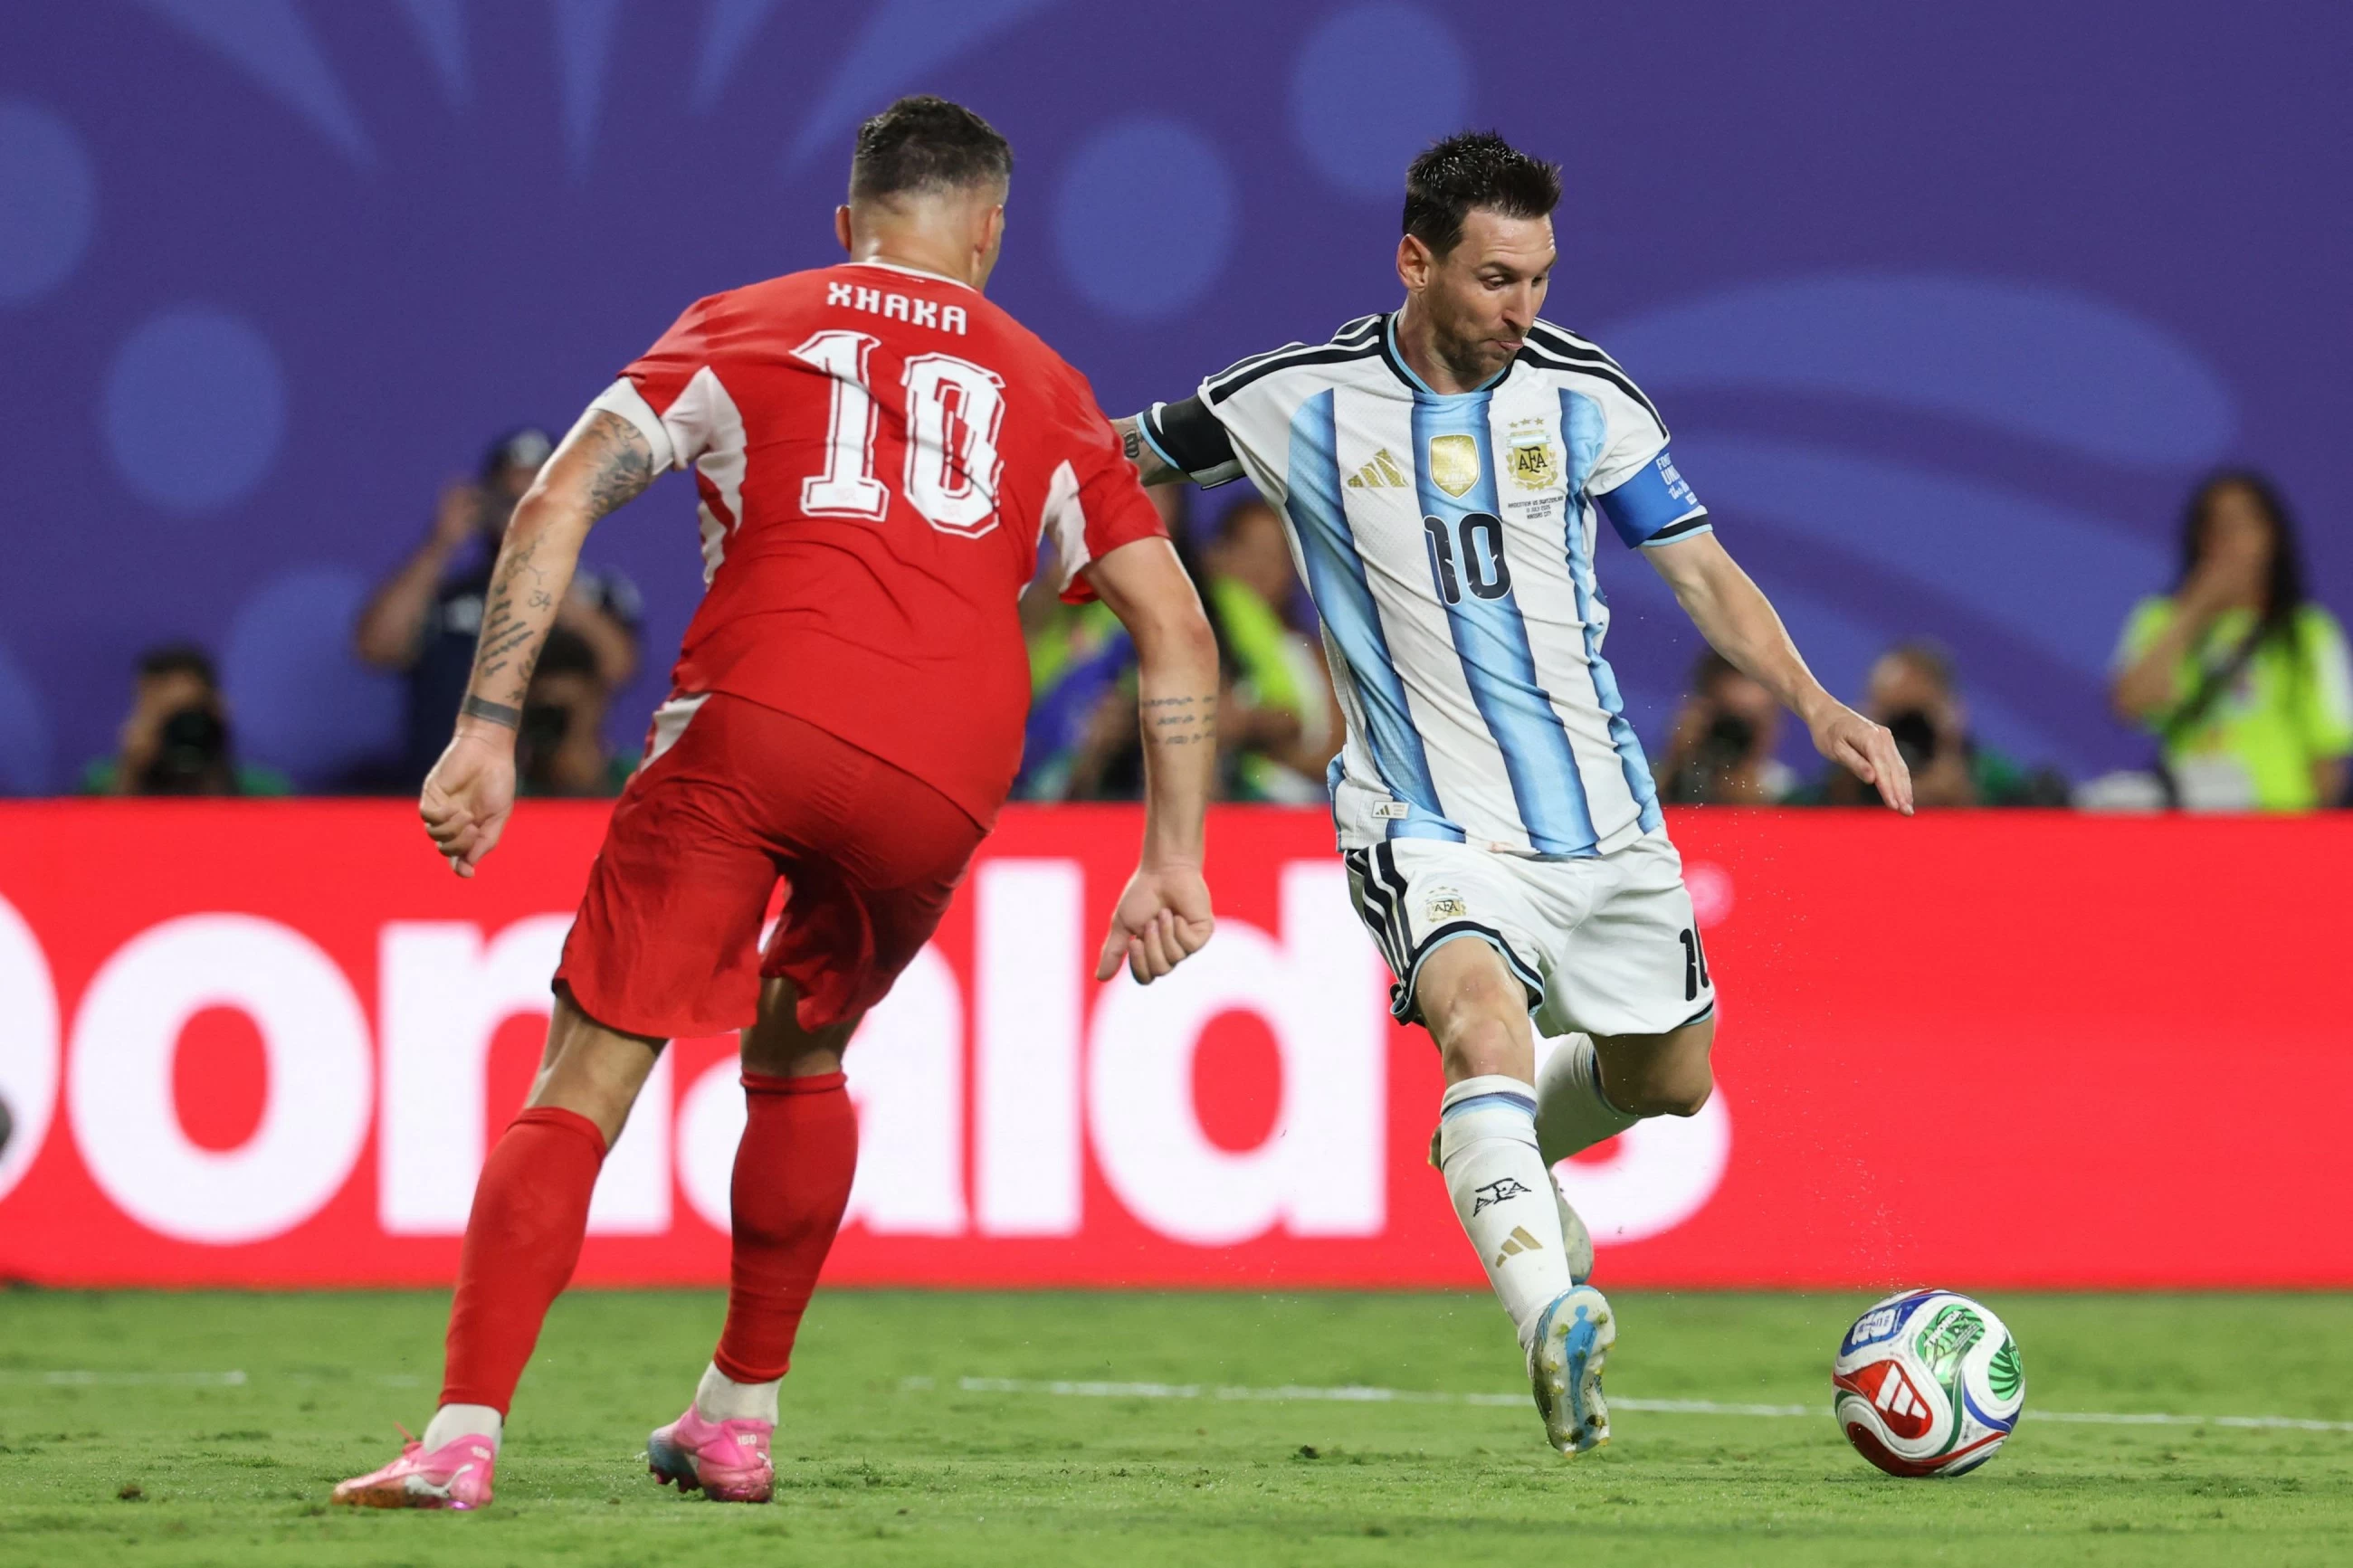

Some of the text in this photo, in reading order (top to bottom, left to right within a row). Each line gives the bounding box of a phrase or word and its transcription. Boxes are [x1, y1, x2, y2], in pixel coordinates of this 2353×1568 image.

[826, 281, 967, 336] XHAKA
[788, 329, 1006, 539] 10
[1518, 445, 1548, 473] AFA
[1424, 511, 1511, 605] 10
[1472, 1177, 1531, 1217] AFA
